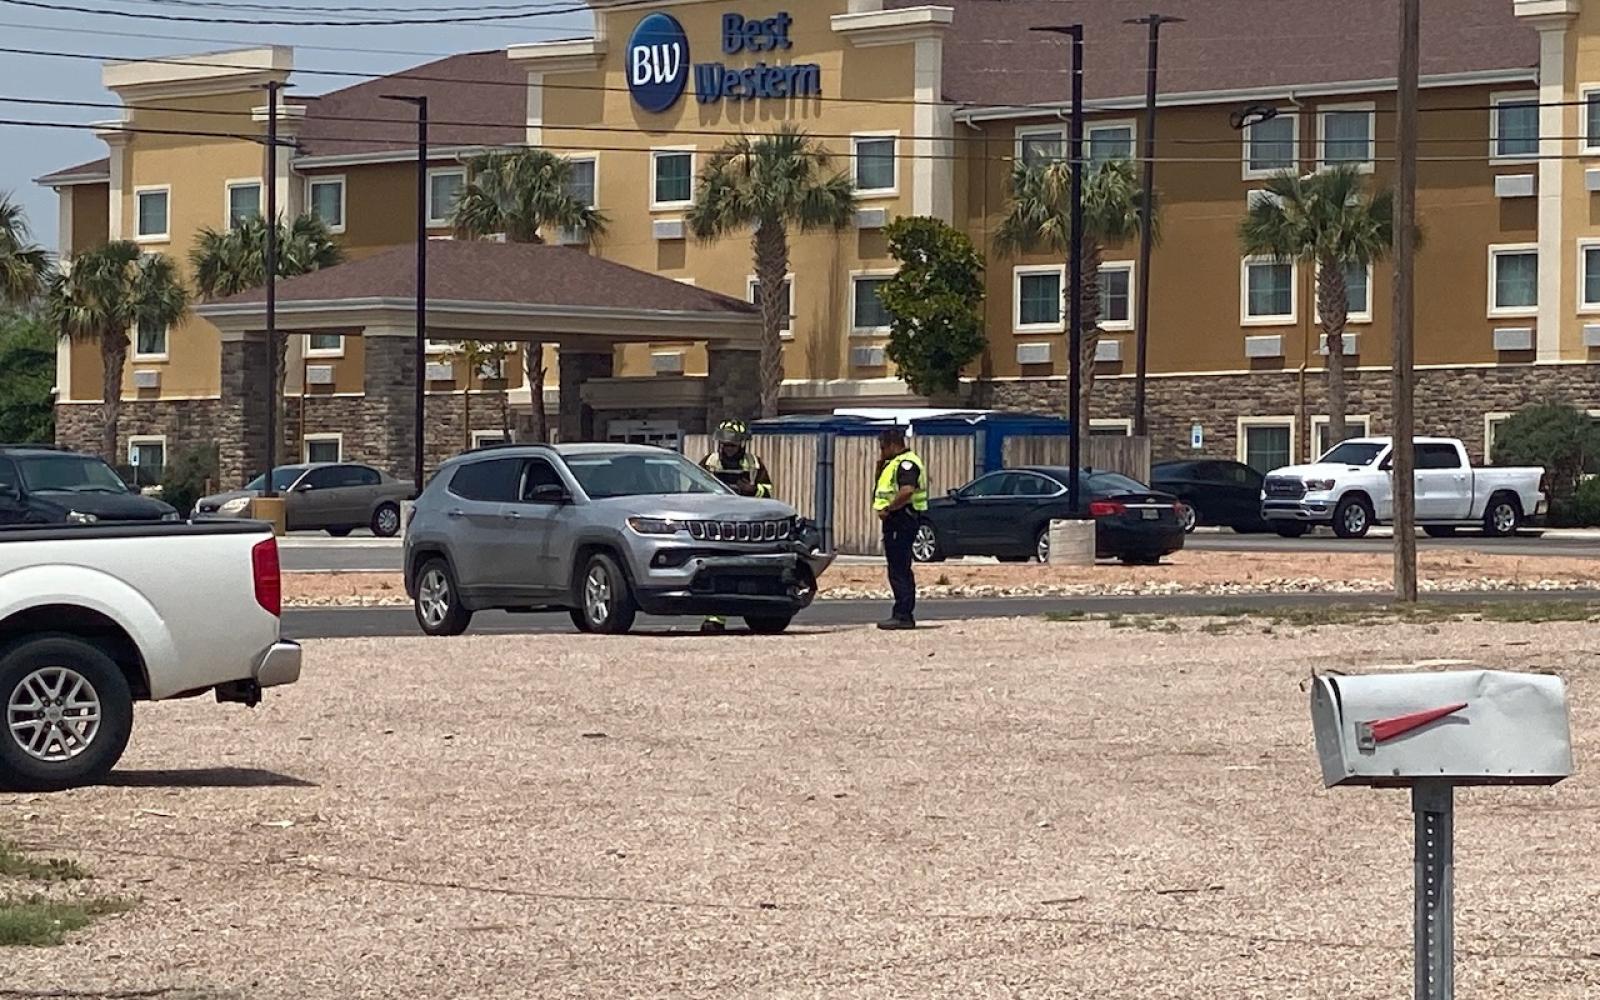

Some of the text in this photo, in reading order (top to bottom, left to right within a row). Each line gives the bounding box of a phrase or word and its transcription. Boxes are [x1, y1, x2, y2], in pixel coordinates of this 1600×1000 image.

[722, 12, 793, 54] Best
[633, 42, 680, 86] BW
[694, 63, 821, 103] Western
